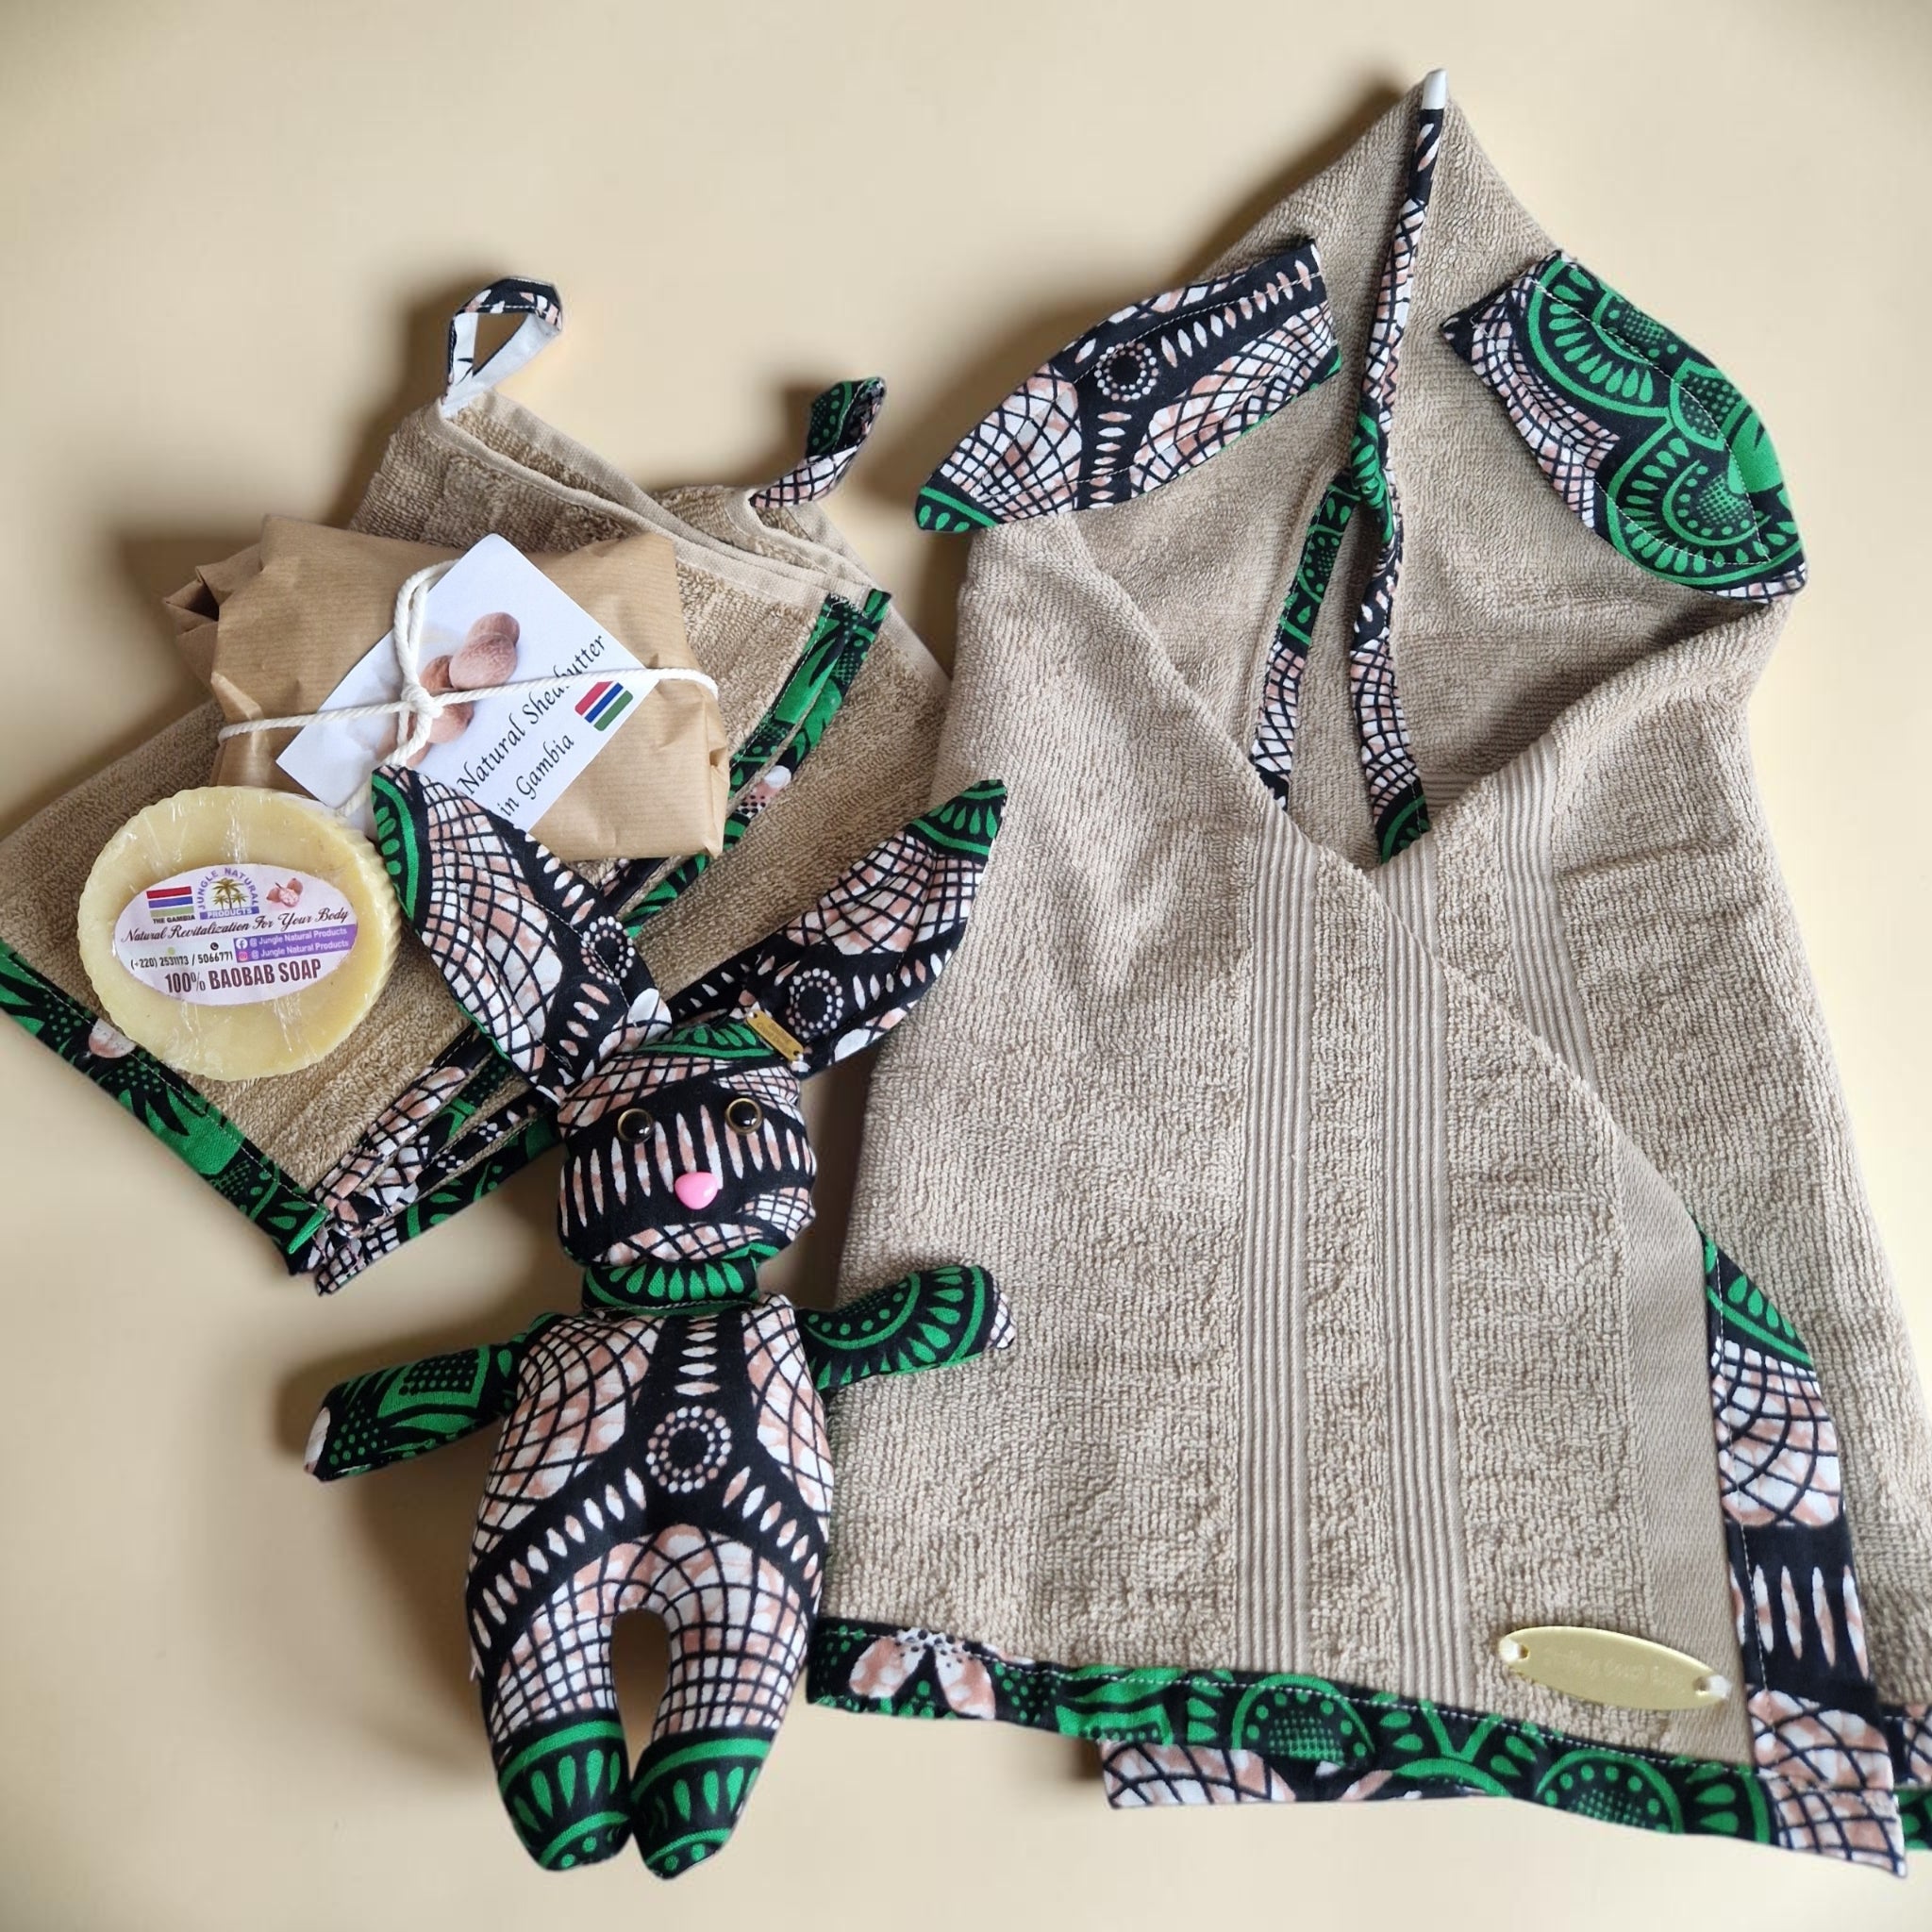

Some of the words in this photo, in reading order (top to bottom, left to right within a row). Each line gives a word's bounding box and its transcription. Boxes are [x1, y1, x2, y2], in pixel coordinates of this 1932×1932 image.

[457, 713, 526, 794] Natural
[498, 797, 520, 817] in
[516, 734, 575, 800] Gambia
[196, 870, 218, 910] JUNGLE
[225, 867, 259, 906] NATURAL
[121, 926, 167, 942] Natural
[168, 921, 250, 940] Revitalization
[252, 915, 274, 930] For
[277, 912, 313, 932] Your
[314, 907, 349, 924] Body
[166, 914, 196, 924] GAMBIA
[208, 908, 253, 920] PRODUCTS
[258, 935, 284, 945] Jungle
[284, 930, 312, 942] Natural
[313, 926, 348, 938] Products
[259, 946, 286, 958] Jungle
[286, 943, 314, 955] Natural
[315, 940, 349, 951] Products
[130, 958, 158, 971] (+220)
[197, 951, 234, 964] 5066771
[164, 971, 207, 993] 100%
[208, 963, 275, 991] BAOBAB
[277, 958, 322, 983] SOAP
